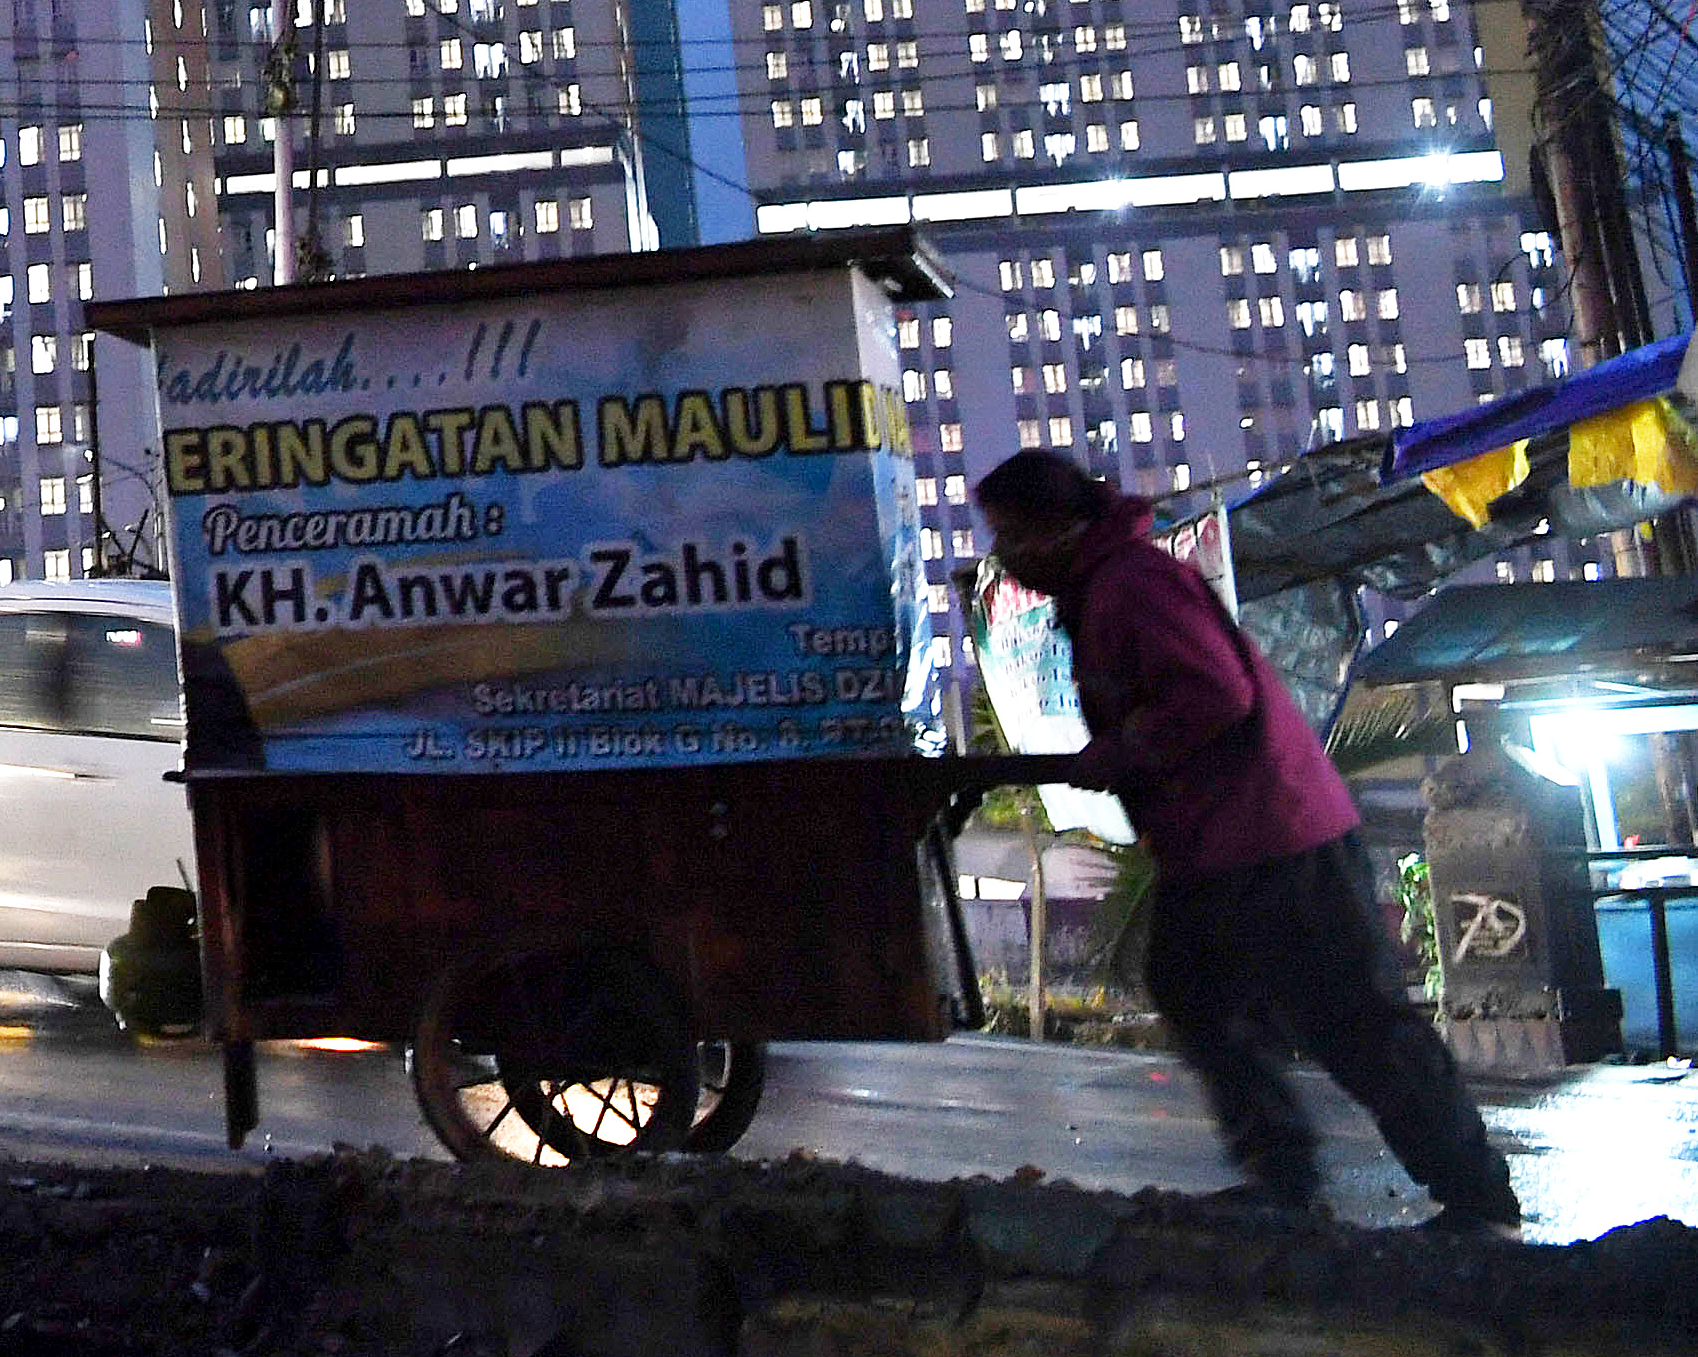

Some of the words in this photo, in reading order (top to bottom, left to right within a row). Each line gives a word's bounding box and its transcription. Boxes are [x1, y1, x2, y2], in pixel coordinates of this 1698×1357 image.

[214, 565, 330, 628] KH.
[348, 562, 572, 622] Anwar
[588, 537, 804, 609] Zahid
[472, 678, 662, 715] Sekretariat
[669, 670, 825, 707] MAJELIS
